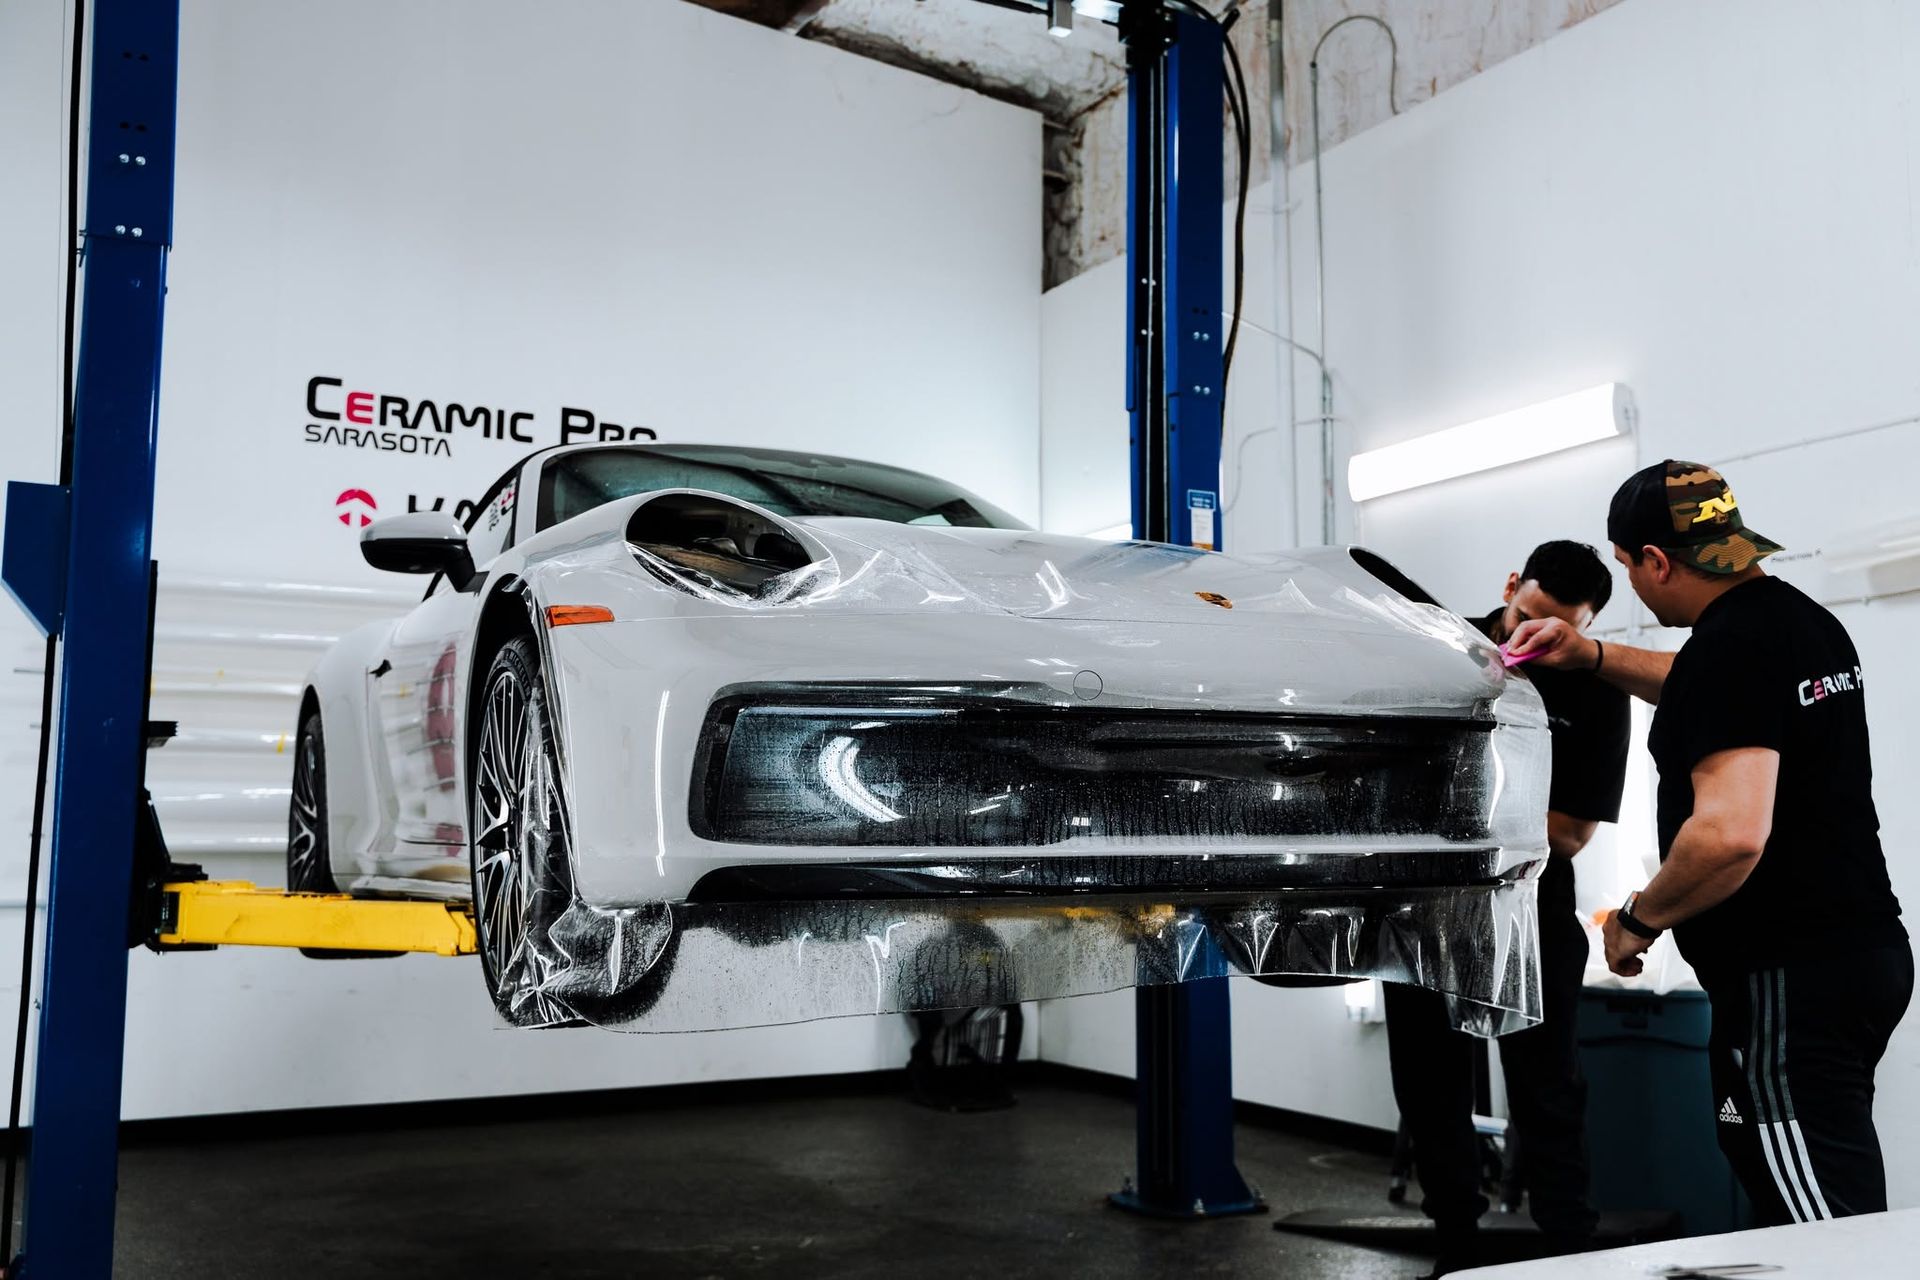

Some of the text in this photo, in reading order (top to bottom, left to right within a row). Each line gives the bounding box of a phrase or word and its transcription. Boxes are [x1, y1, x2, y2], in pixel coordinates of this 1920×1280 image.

[306, 376, 534, 443] CERAMIC
[305, 424, 451, 457] SARASOTA
[1719, 1113, 1743, 1124] adidas
